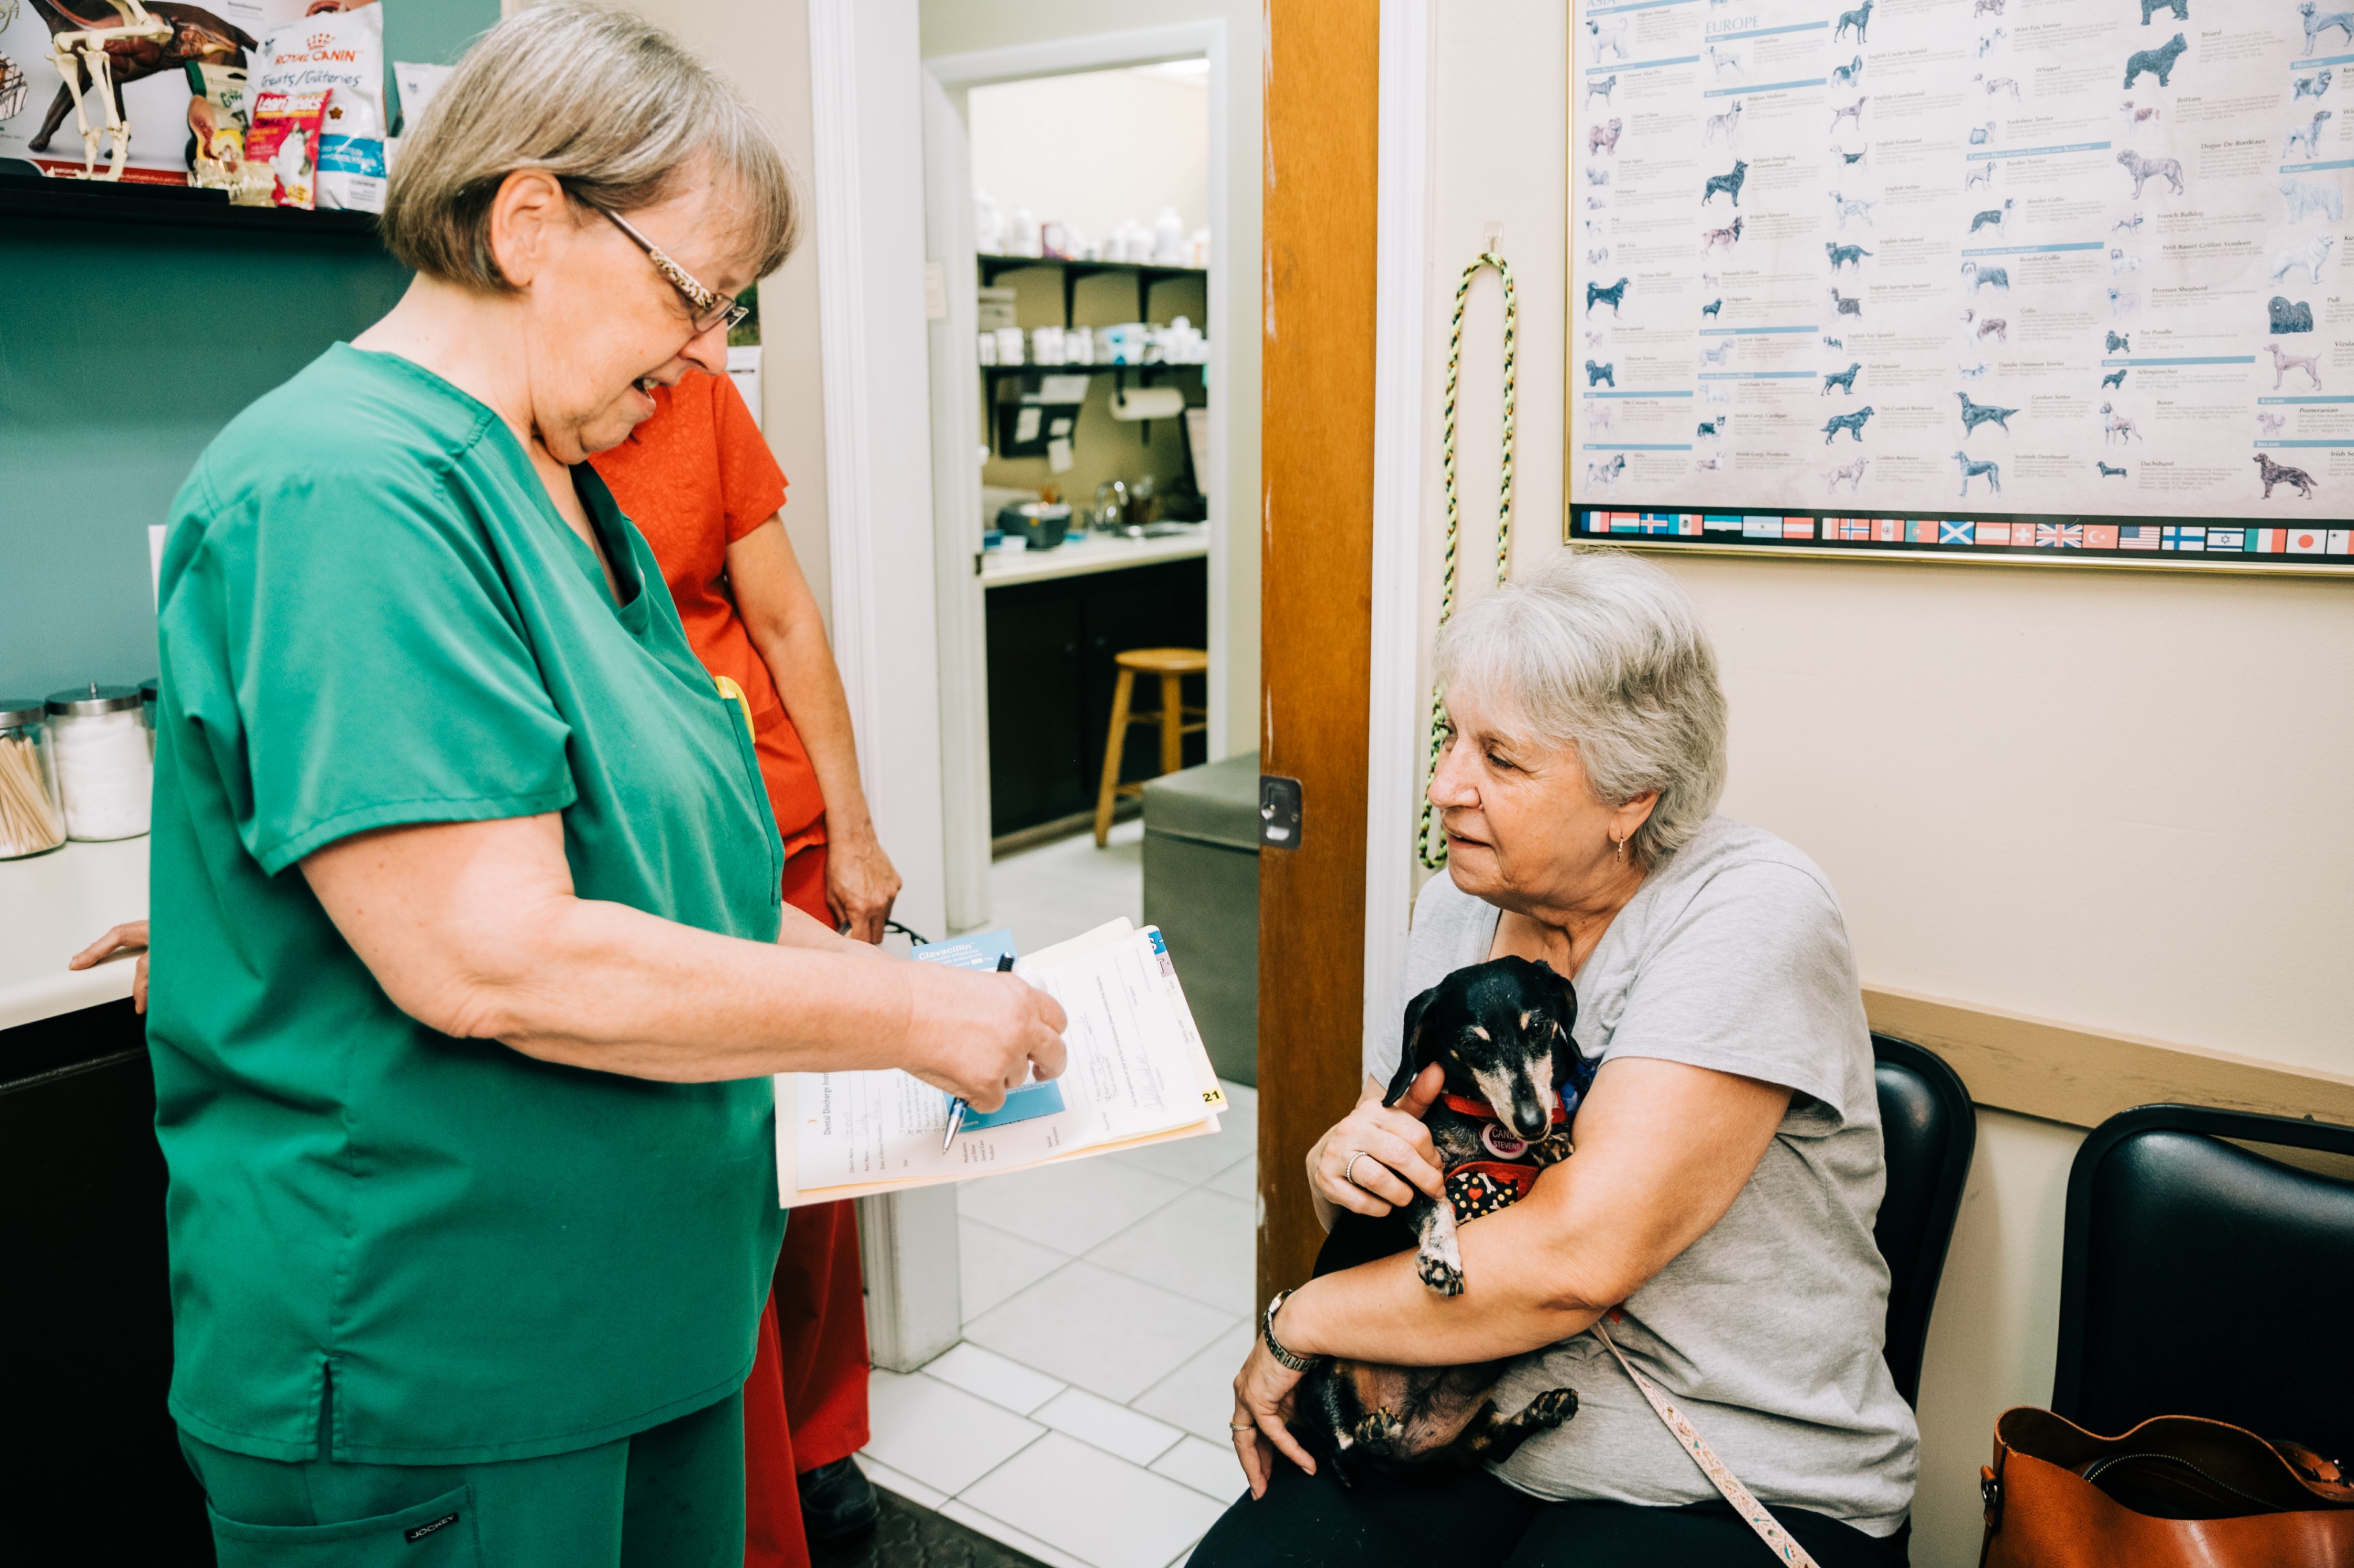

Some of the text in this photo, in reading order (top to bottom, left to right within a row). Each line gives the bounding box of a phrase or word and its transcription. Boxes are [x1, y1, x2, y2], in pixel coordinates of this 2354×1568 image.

[1705, 16, 1760, 33] EUROPE
[275, 51, 356, 65] ROYAL CANIN
[2178, 285, 2208, 293] Shepherd
[919, 943, 972, 960] Clavacillin
[1203, 1090, 1220, 1102] 21
[823, 1087, 832, 1135] Dental Discharge
[1492, 1128, 1520, 1140] CAND
[1493, 1140, 1520, 1150] STEVENS
[411, 1515, 454, 1538] JOCKEY
